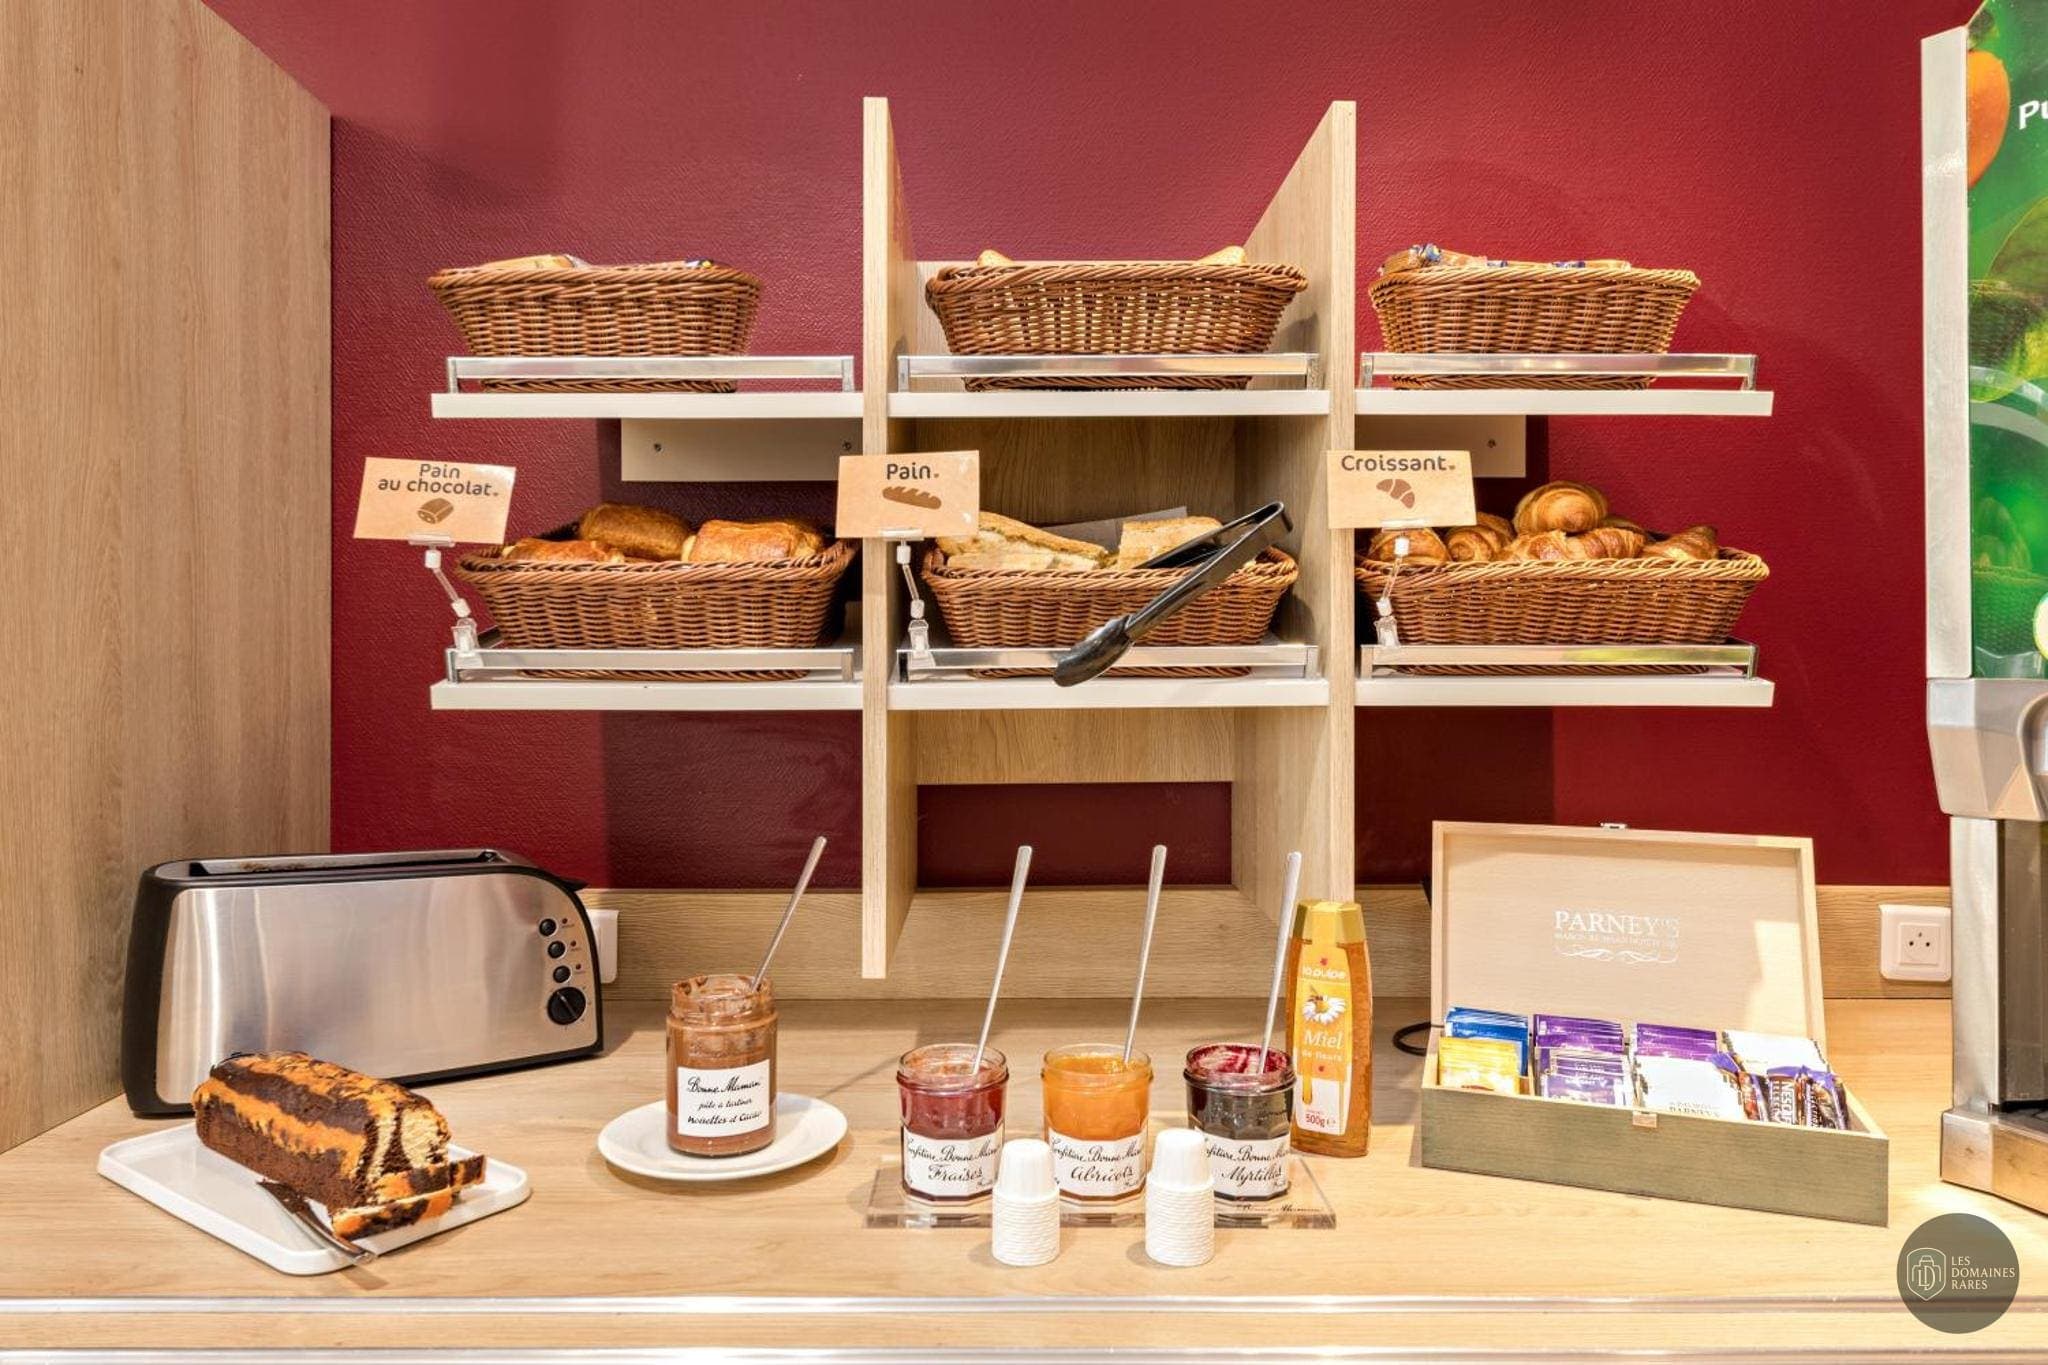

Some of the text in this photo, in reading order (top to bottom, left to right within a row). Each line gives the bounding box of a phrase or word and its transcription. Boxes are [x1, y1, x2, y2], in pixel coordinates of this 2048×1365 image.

[419, 463, 460, 479] Pain
[886, 462, 939, 480] Pain.
[1341, 454, 1455, 471] Croissant.
[378, 478, 499, 496] au chocolat.
[1304, 1029, 1344, 1050] Miel
[687, 1076, 761, 1093] Bonne Maman
[928, 1163, 984, 1182] Fraises
[1221, 1164, 1282, 1187] Myrtilles
